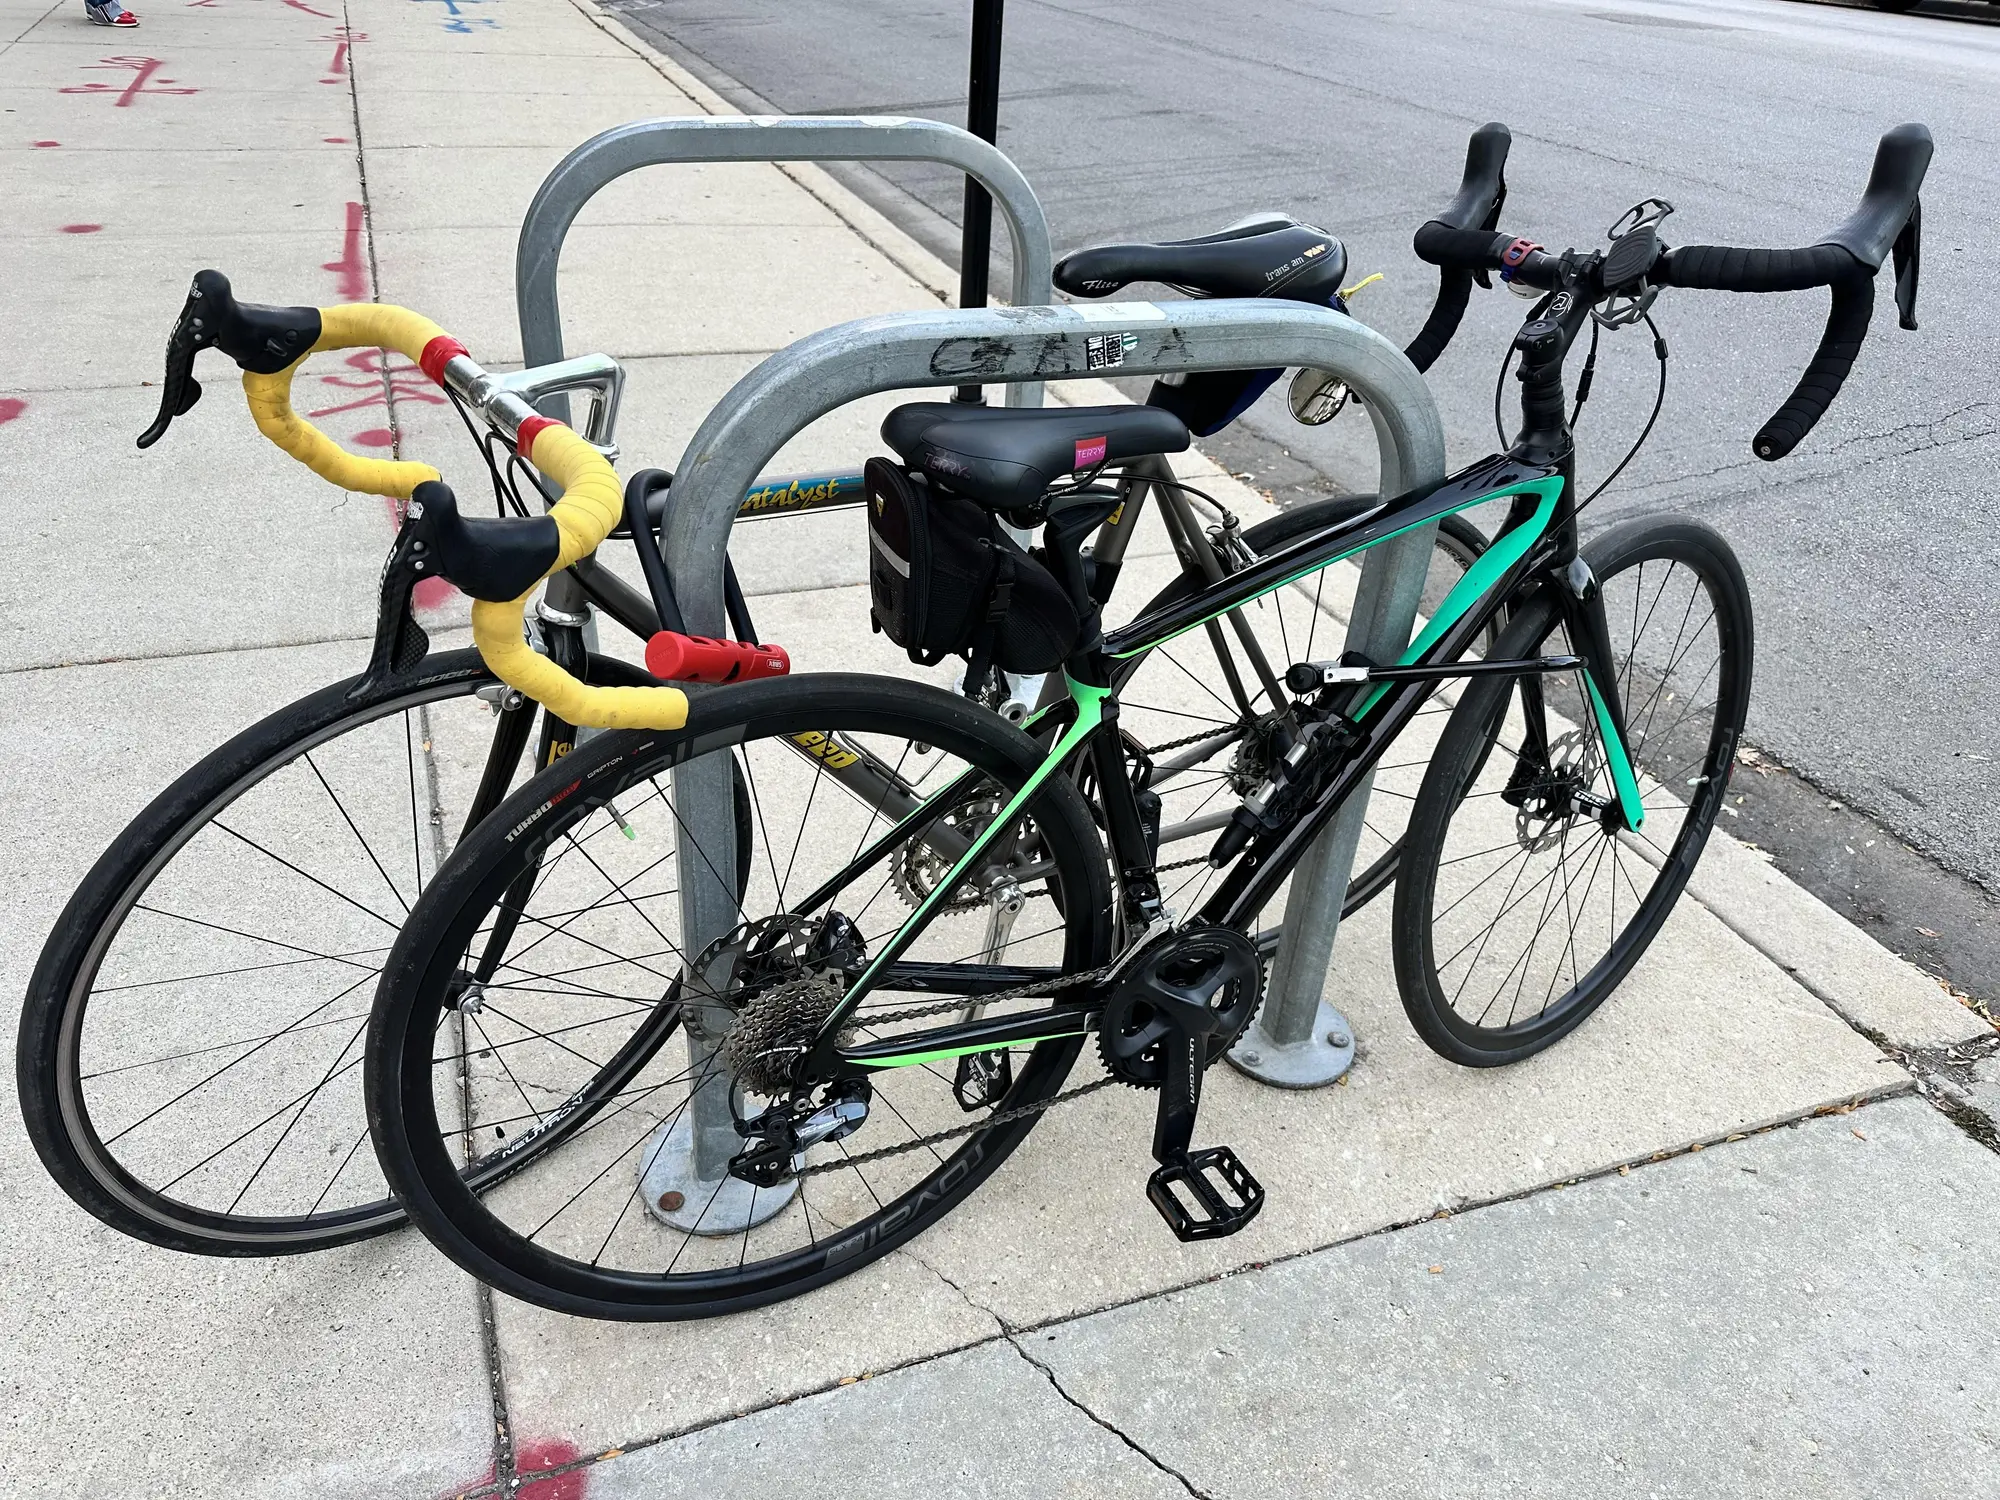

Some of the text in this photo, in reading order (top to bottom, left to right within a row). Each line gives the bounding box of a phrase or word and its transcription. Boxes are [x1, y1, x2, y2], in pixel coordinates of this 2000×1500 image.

[1265, 256, 1305, 281] trans am
[1082, 279, 1119, 290] Flite
[923, 451, 972, 478] TERRY
[1077, 446, 1104, 460] TERRY
[586, 755, 624, 780] GRIPTON
[504, 802, 552, 843] TURBO
[1188, 1037, 1196, 1105] ULTEGRA
[501, 1095, 584, 1159] NEUTRON
